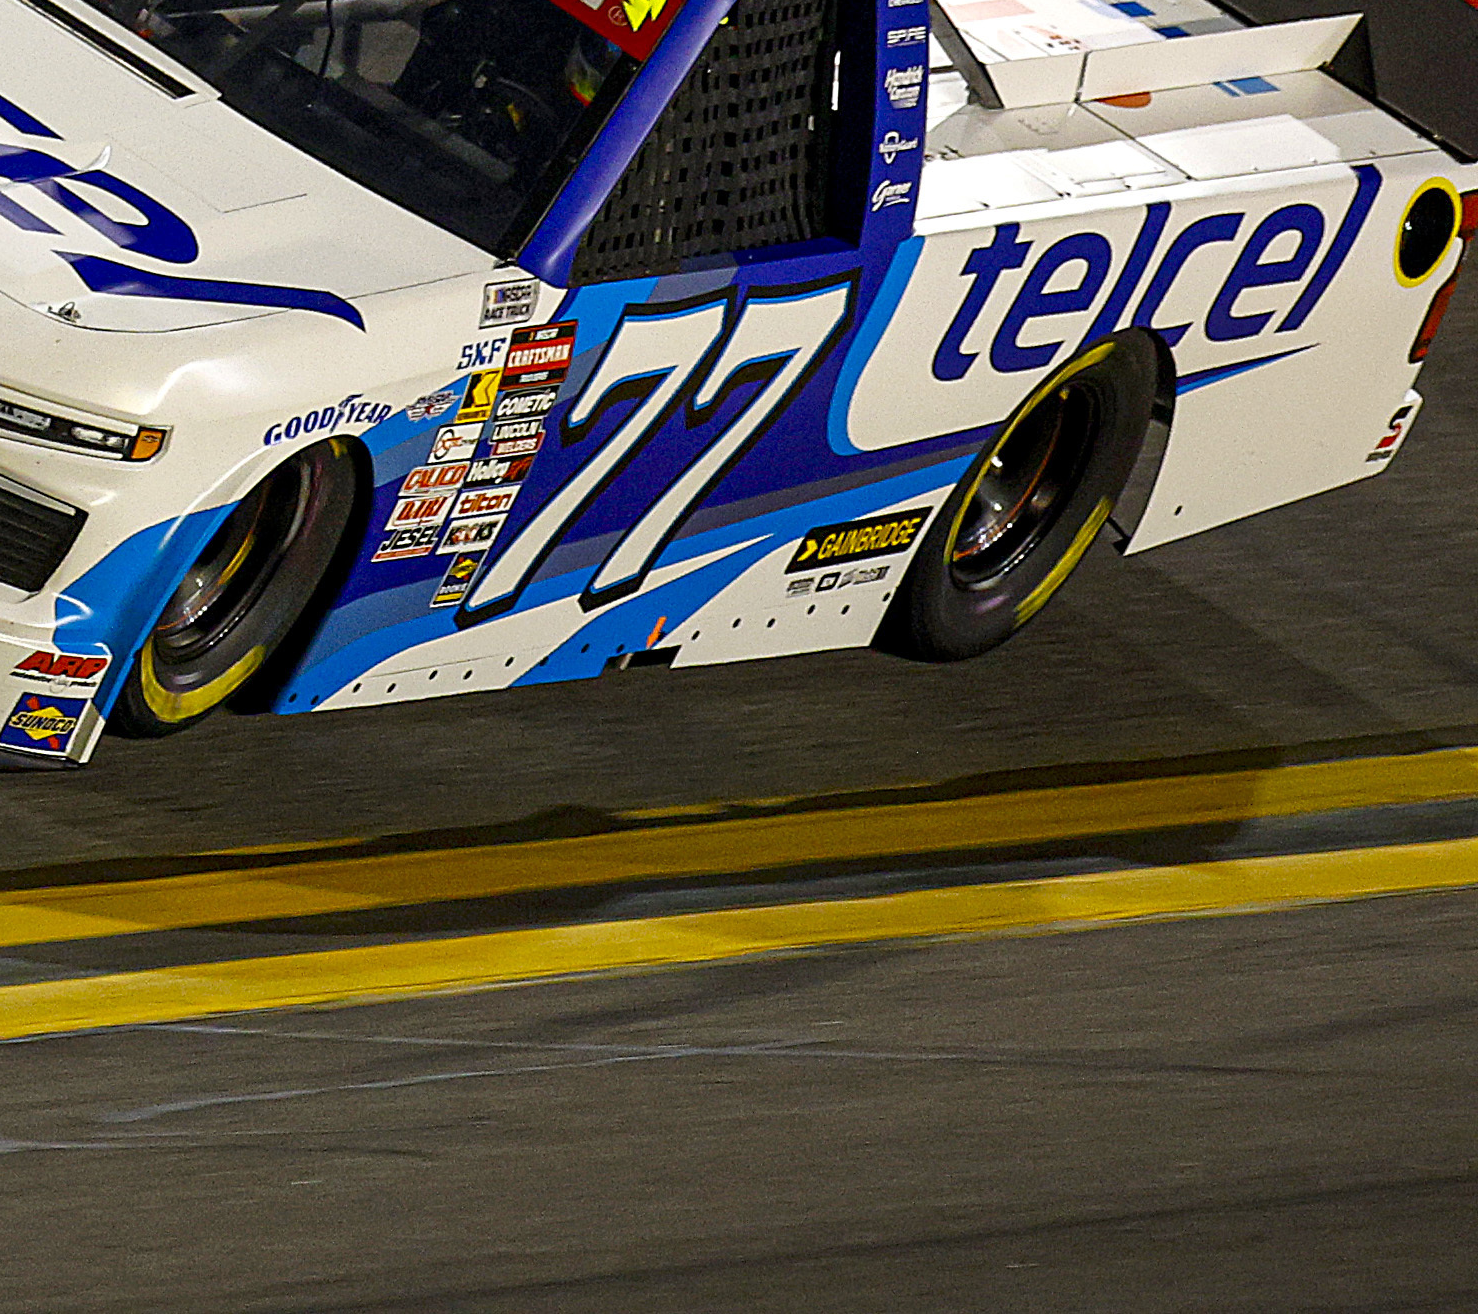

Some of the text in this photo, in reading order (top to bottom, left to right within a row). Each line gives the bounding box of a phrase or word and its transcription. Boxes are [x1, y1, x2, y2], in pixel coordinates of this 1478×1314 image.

[931, 165, 1383, 382] telcel
[456, 337, 507, 370] SKF
[508, 344, 571, 368] CRAFTSMAN
[497, 392, 556, 416] COMETIC
[264, 395, 393, 447] GOODYEAR
[493, 422, 540, 442] LINCOLN
[462, 274, 857, 622] 77
[404, 465, 467, 491] CALICO
[459, 492, 512, 514] tilton
[381, 525, 440, 552] JESEL
[817, 516, 922, 561] GAINBRIDGE
[14, 650, 108, 680] ARP
[14, 713, 76, 734] SUNOCO
